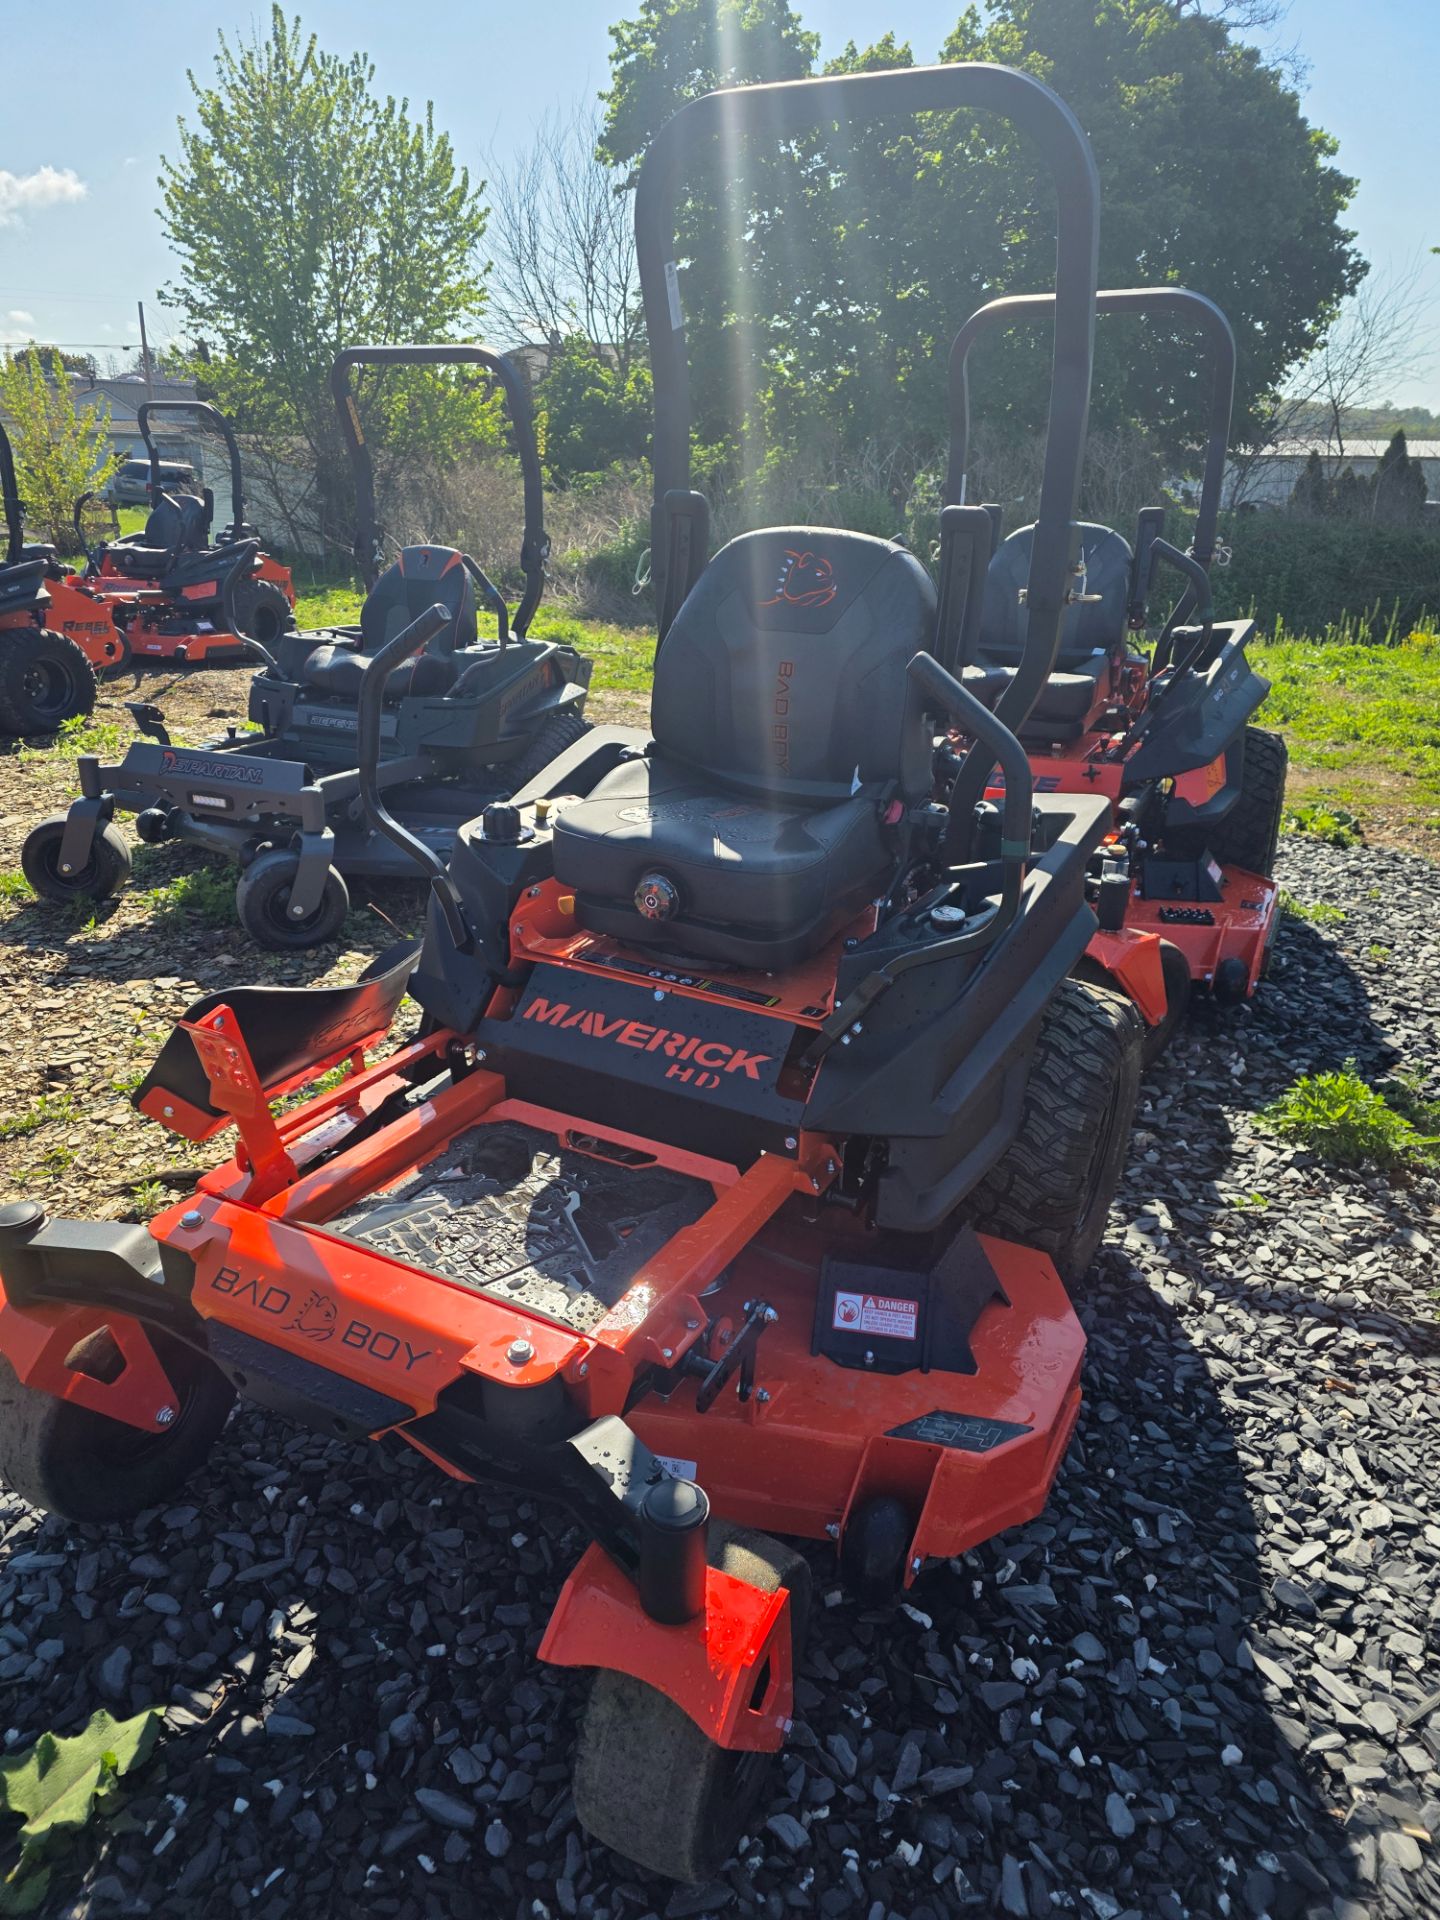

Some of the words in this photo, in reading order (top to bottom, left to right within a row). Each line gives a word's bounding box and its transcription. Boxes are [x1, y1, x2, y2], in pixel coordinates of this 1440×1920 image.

[63, 621, 109, 633] REBEL
[776, 661, 793, 715] BAD
[775, 725, 791, 774] BOY
[174, 759, 263, 784] SPARTAN
[523, 998, 773, 1080] MAVERICK
[665, 1064, 720, 1089] HD
[211, 1266, 291, 1314] BAD
[342, 1320, 432, 1371] BOY
[878, 1299, 915, 1313] DANGER
